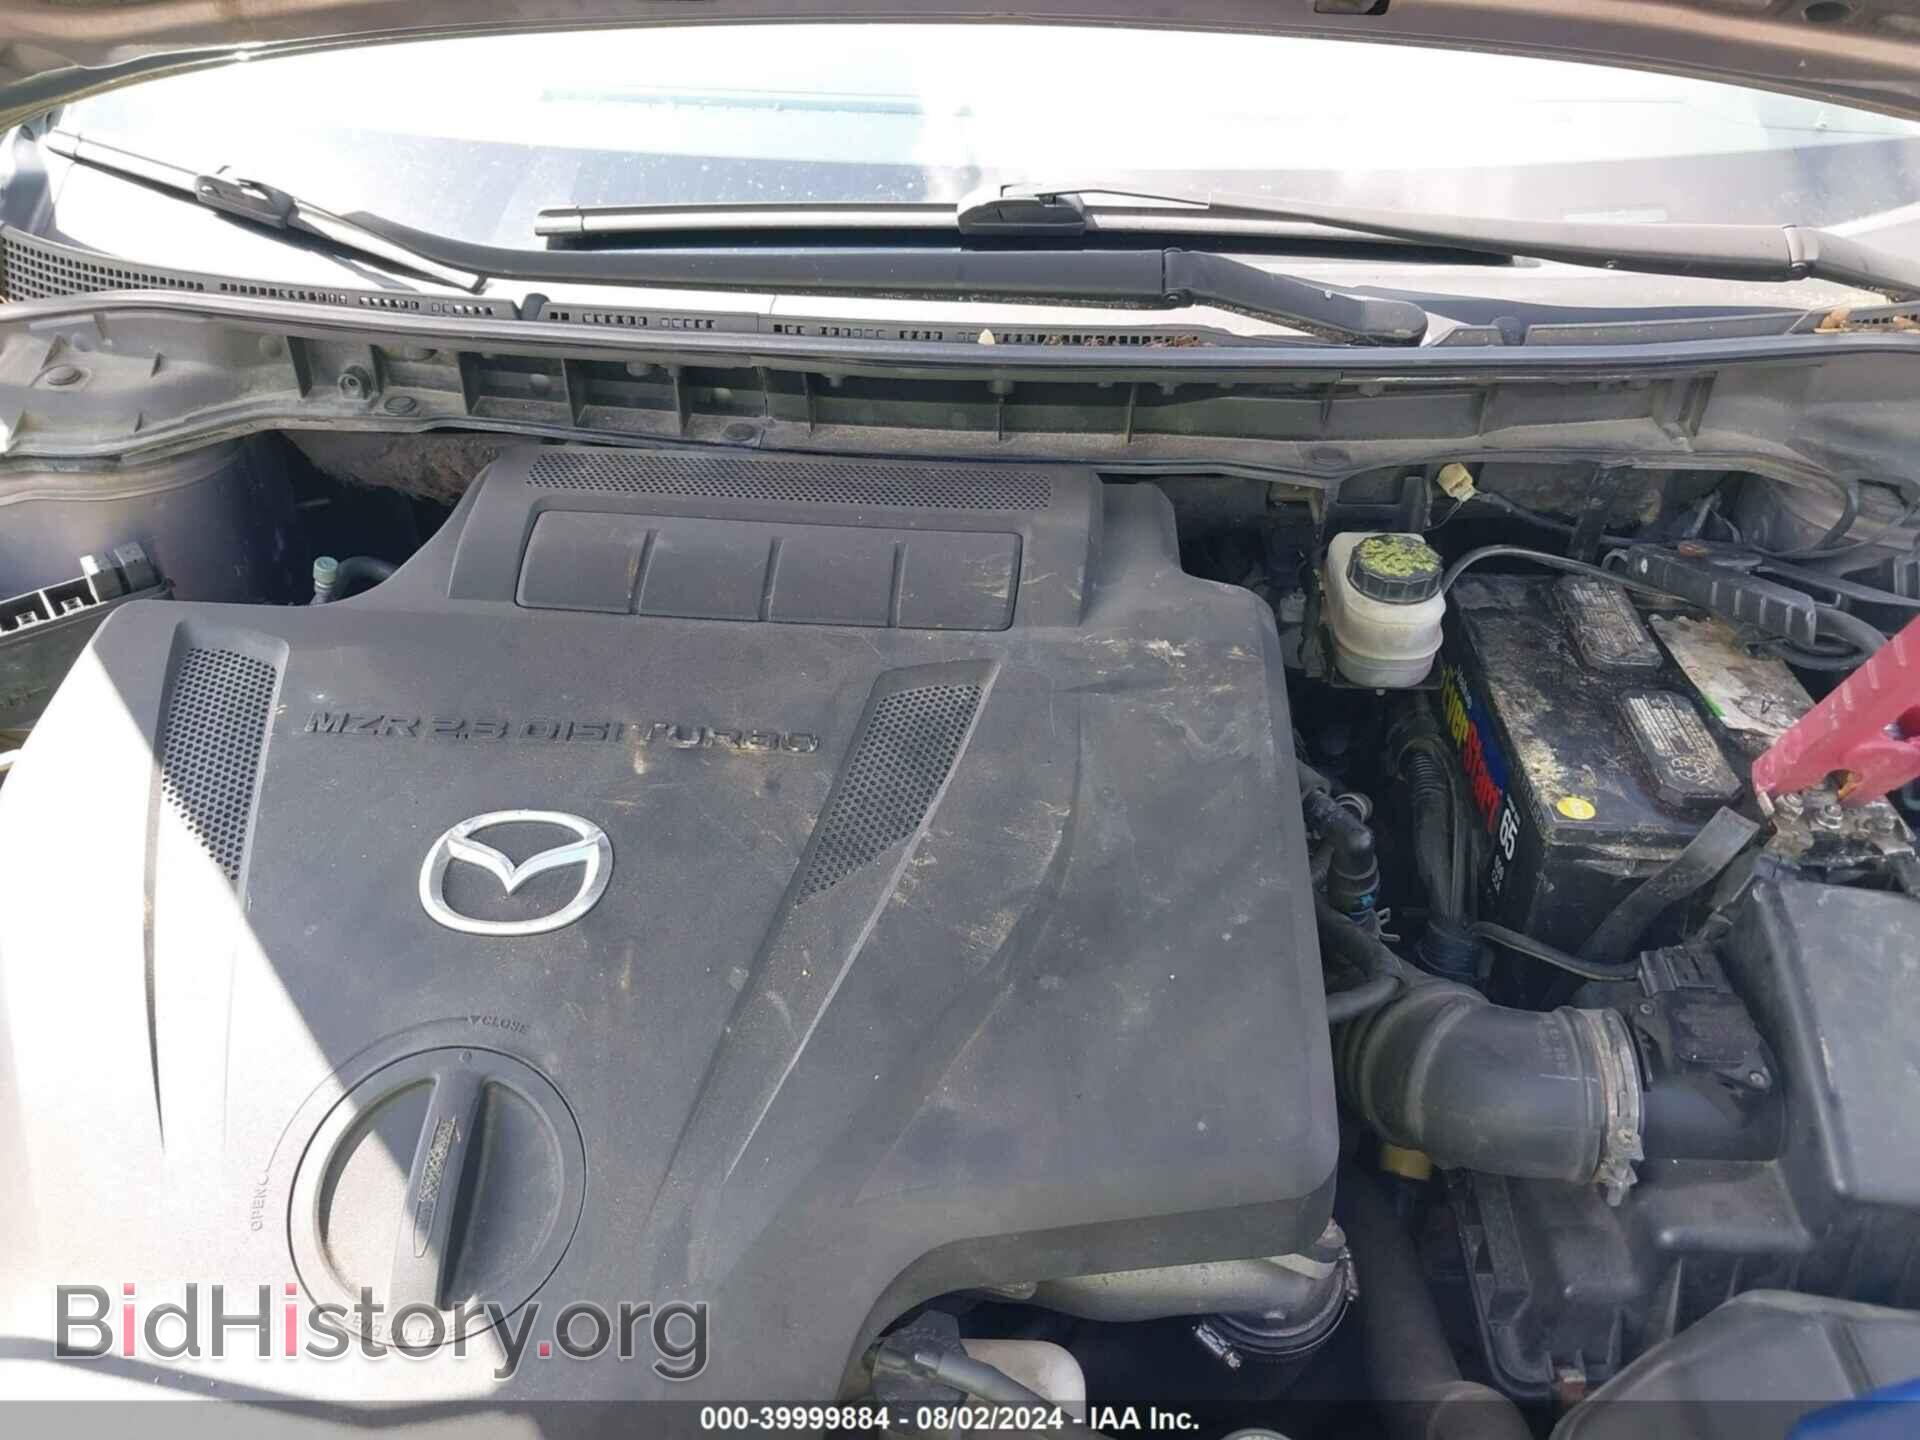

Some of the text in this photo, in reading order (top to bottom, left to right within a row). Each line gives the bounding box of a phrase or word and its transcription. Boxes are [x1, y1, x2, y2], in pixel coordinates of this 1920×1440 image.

[304, 711, 421, 736] MZR
[431, 714, 509, 740] 2.3
[1499, 808, 1519, 861] 65
